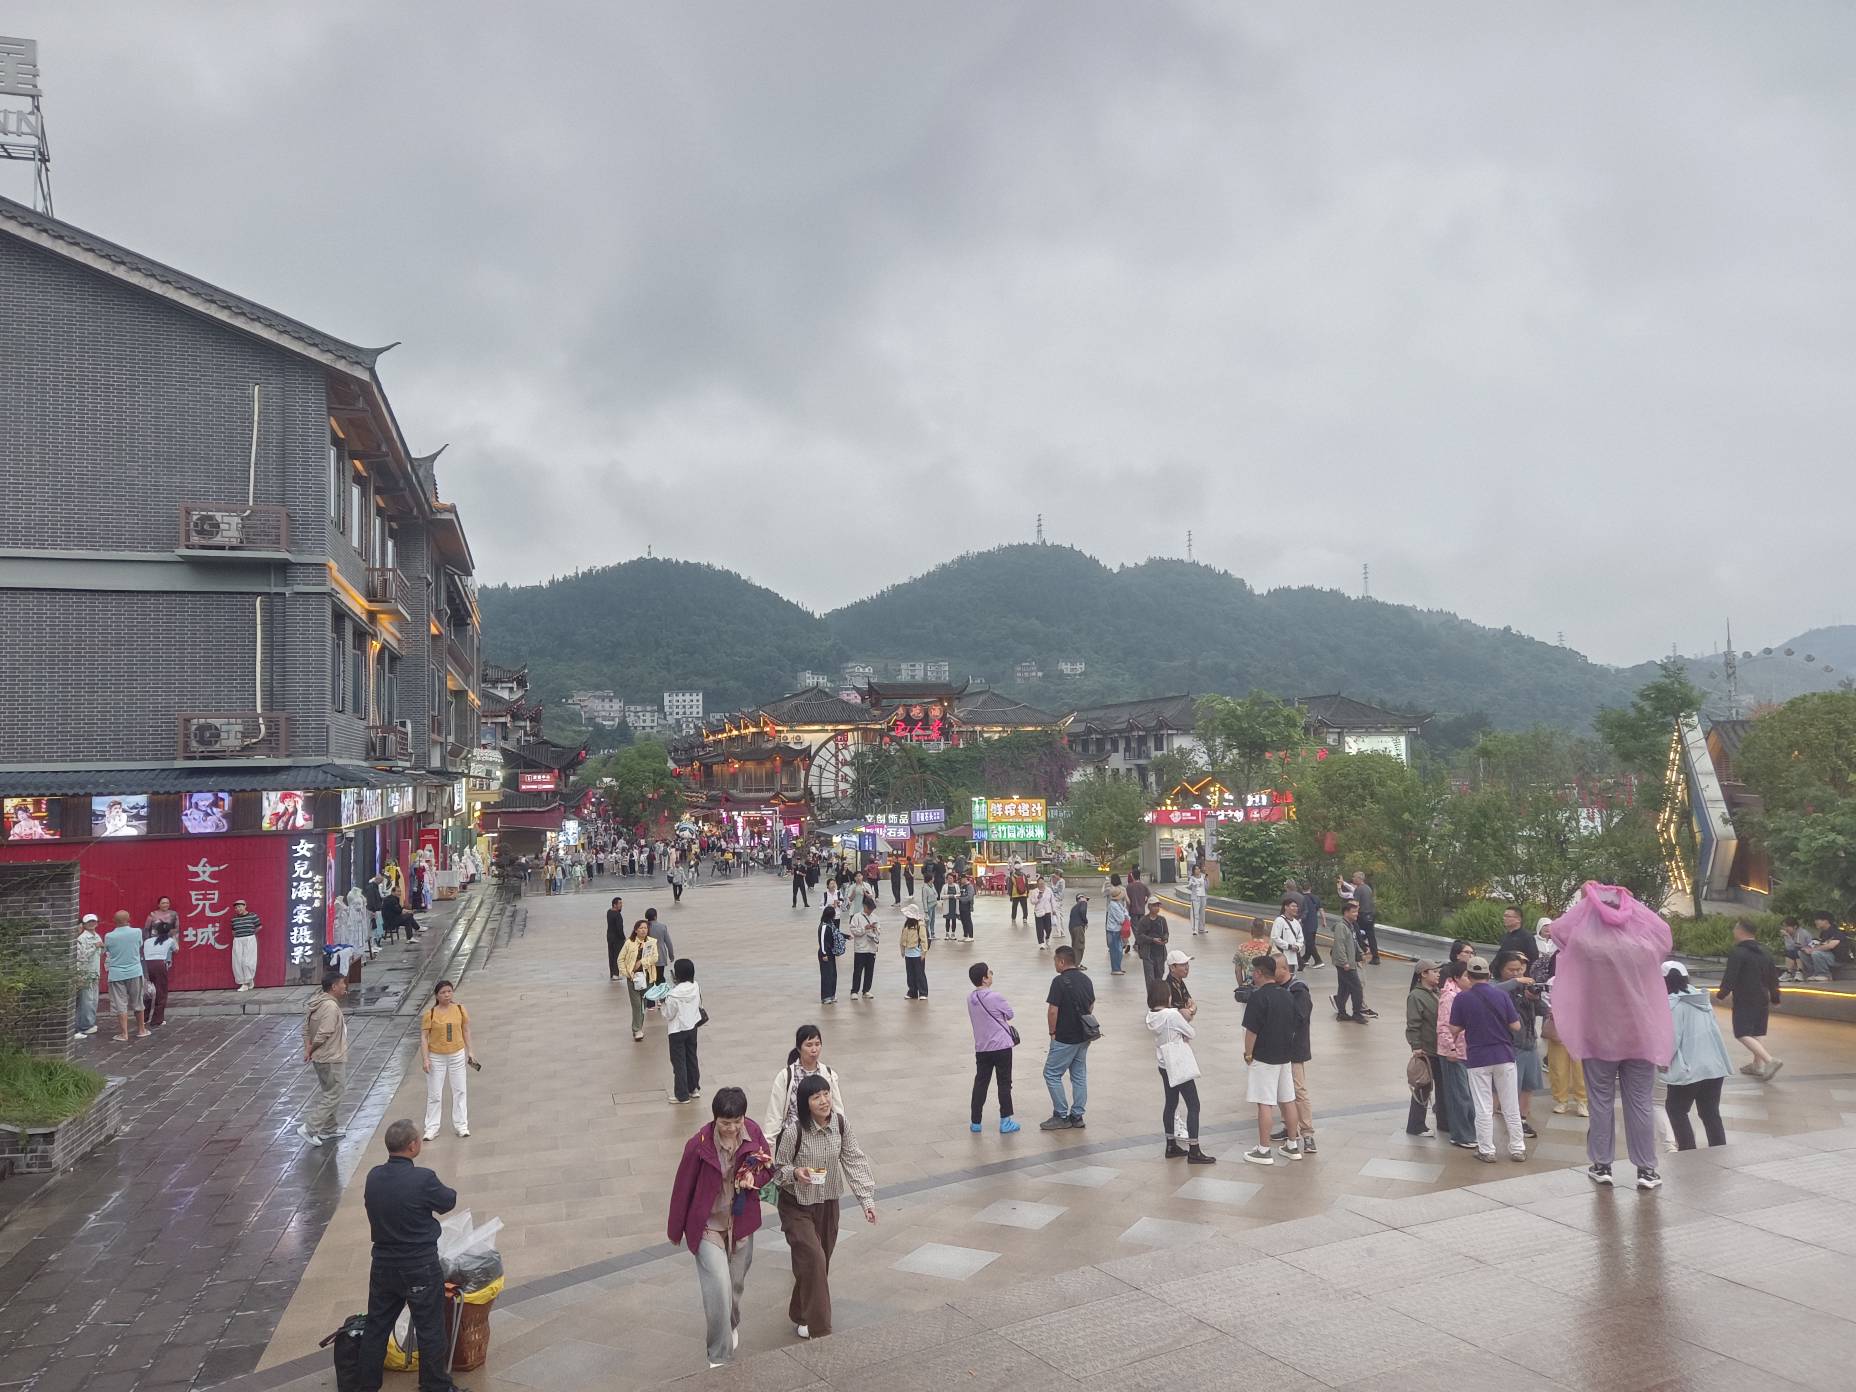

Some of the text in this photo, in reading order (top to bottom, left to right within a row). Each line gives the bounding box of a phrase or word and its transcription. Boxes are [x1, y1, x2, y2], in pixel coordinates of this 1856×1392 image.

[990, 802, 1043, 817] 鲜榨橙汁
[864, 812, 909, 825] 文创饰品
